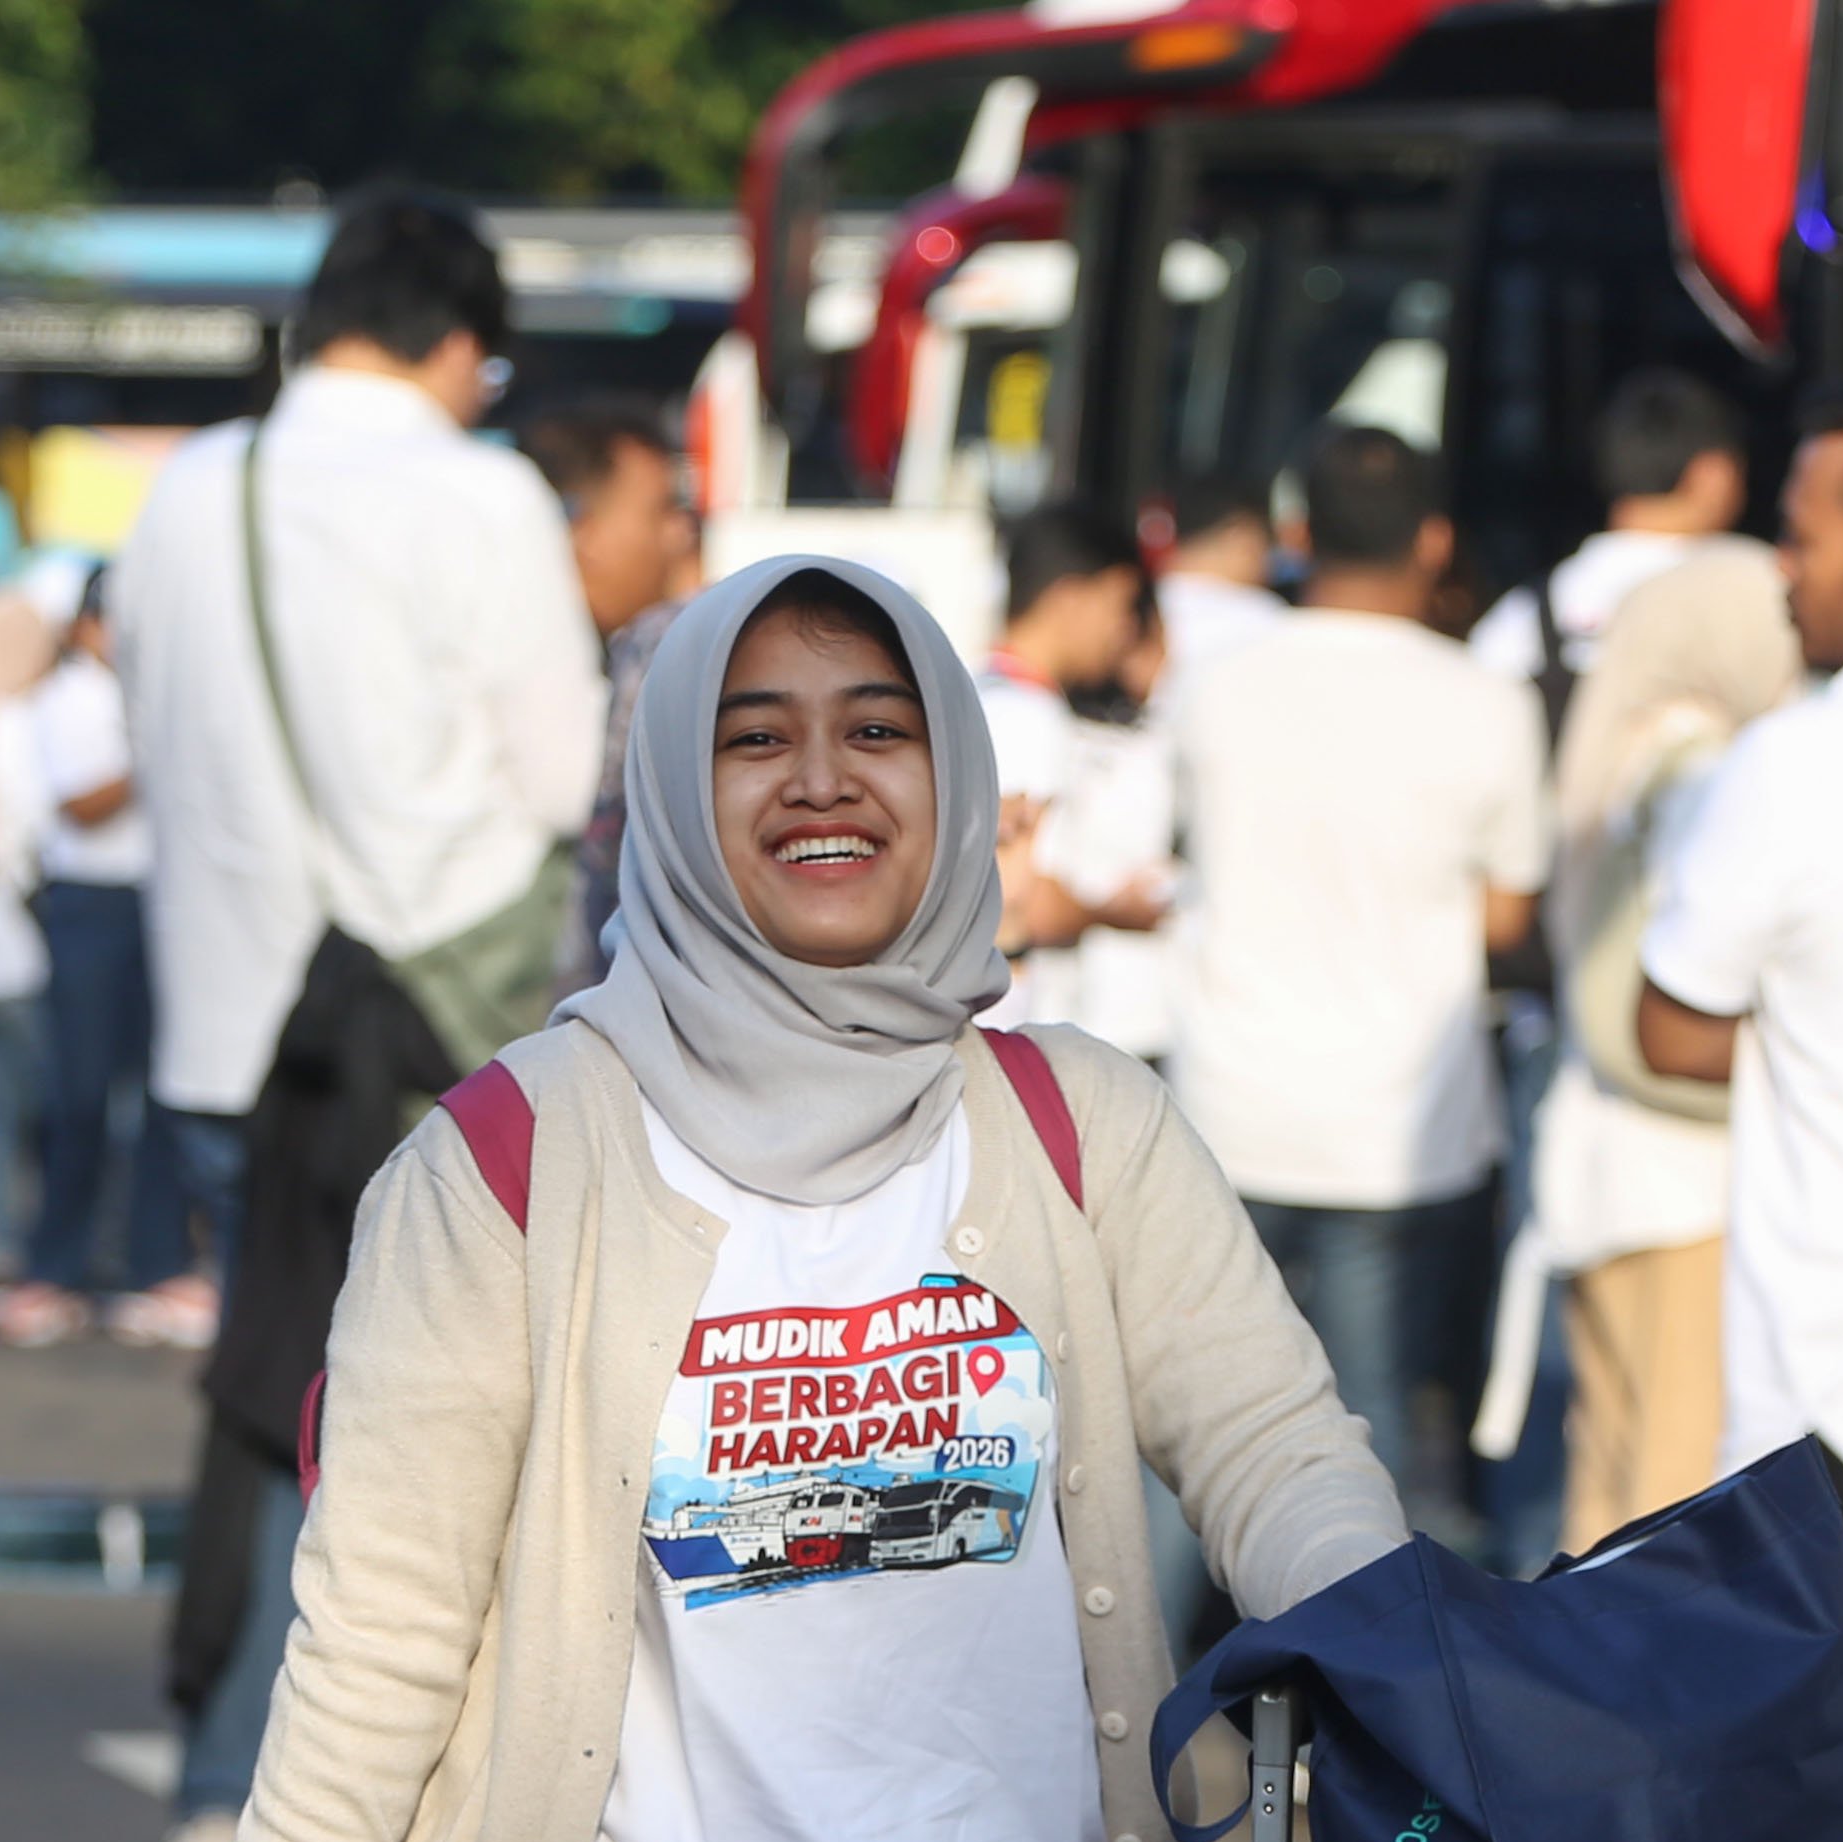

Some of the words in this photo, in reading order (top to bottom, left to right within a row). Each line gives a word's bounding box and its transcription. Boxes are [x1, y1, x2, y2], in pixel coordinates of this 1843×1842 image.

[700, 1318, 849, 1367] MUDIK
[862, 1292, 998, 1354] AMAN
[710, 1351, 960, 1428] BERBAGI
[707, 1404, 958, 1475] HARAPAN
[944, 1438, 1010, 1469] 2026
